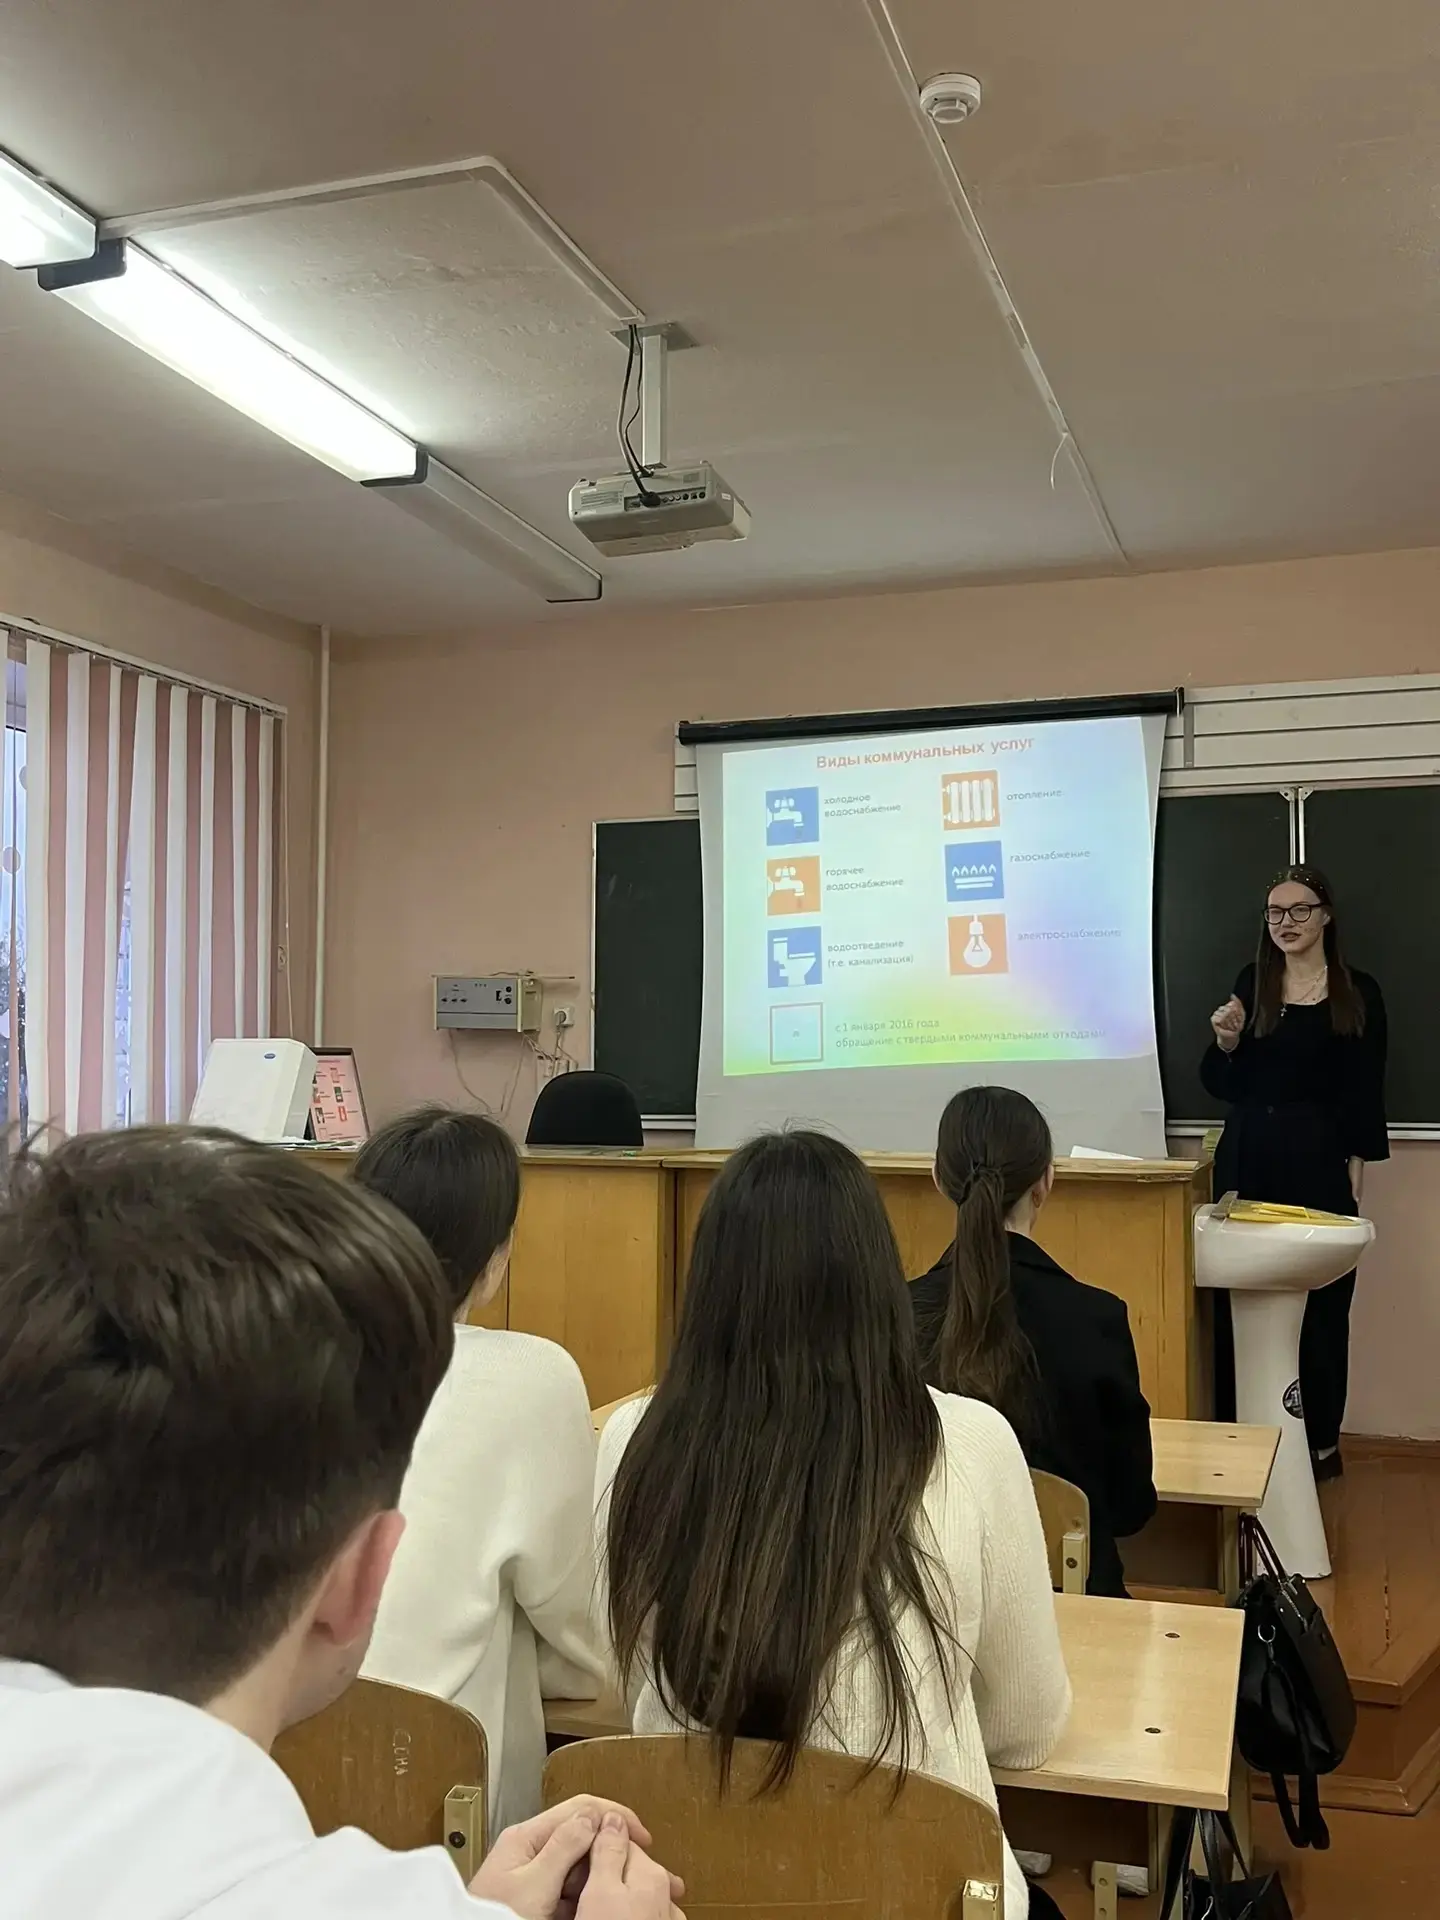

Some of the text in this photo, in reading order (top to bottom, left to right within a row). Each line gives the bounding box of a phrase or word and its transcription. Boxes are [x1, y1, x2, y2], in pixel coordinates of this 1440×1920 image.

[816, 737, 1035, 769] Виды коммунальных услуг
[824, 794, 871, 805] холодное
[1006, 789, 1063, 801] отопление
[824, 804, 901, 818] водоснабжение
[1009, 850, 1091, 863] газоснабжение
[825, 867, 864, 877] горячее
[826, 879, 904, 891] водоснабжение
[1017, 928, 1122, 941] электроснабжение
[827, 940, 904, 953] водоотведение
[848, 954, 914, 967] канализация)
[850, 1021, 886, 1033] января
[889, 1019, 913, 1030] 2016
[916, 1019, 940, 1030] года
[835, 1037, 895, 1048] обращение
[959, 1031, 1049, 1042] коммунальными
[1052, 1029, 1106, 1041] отходами
